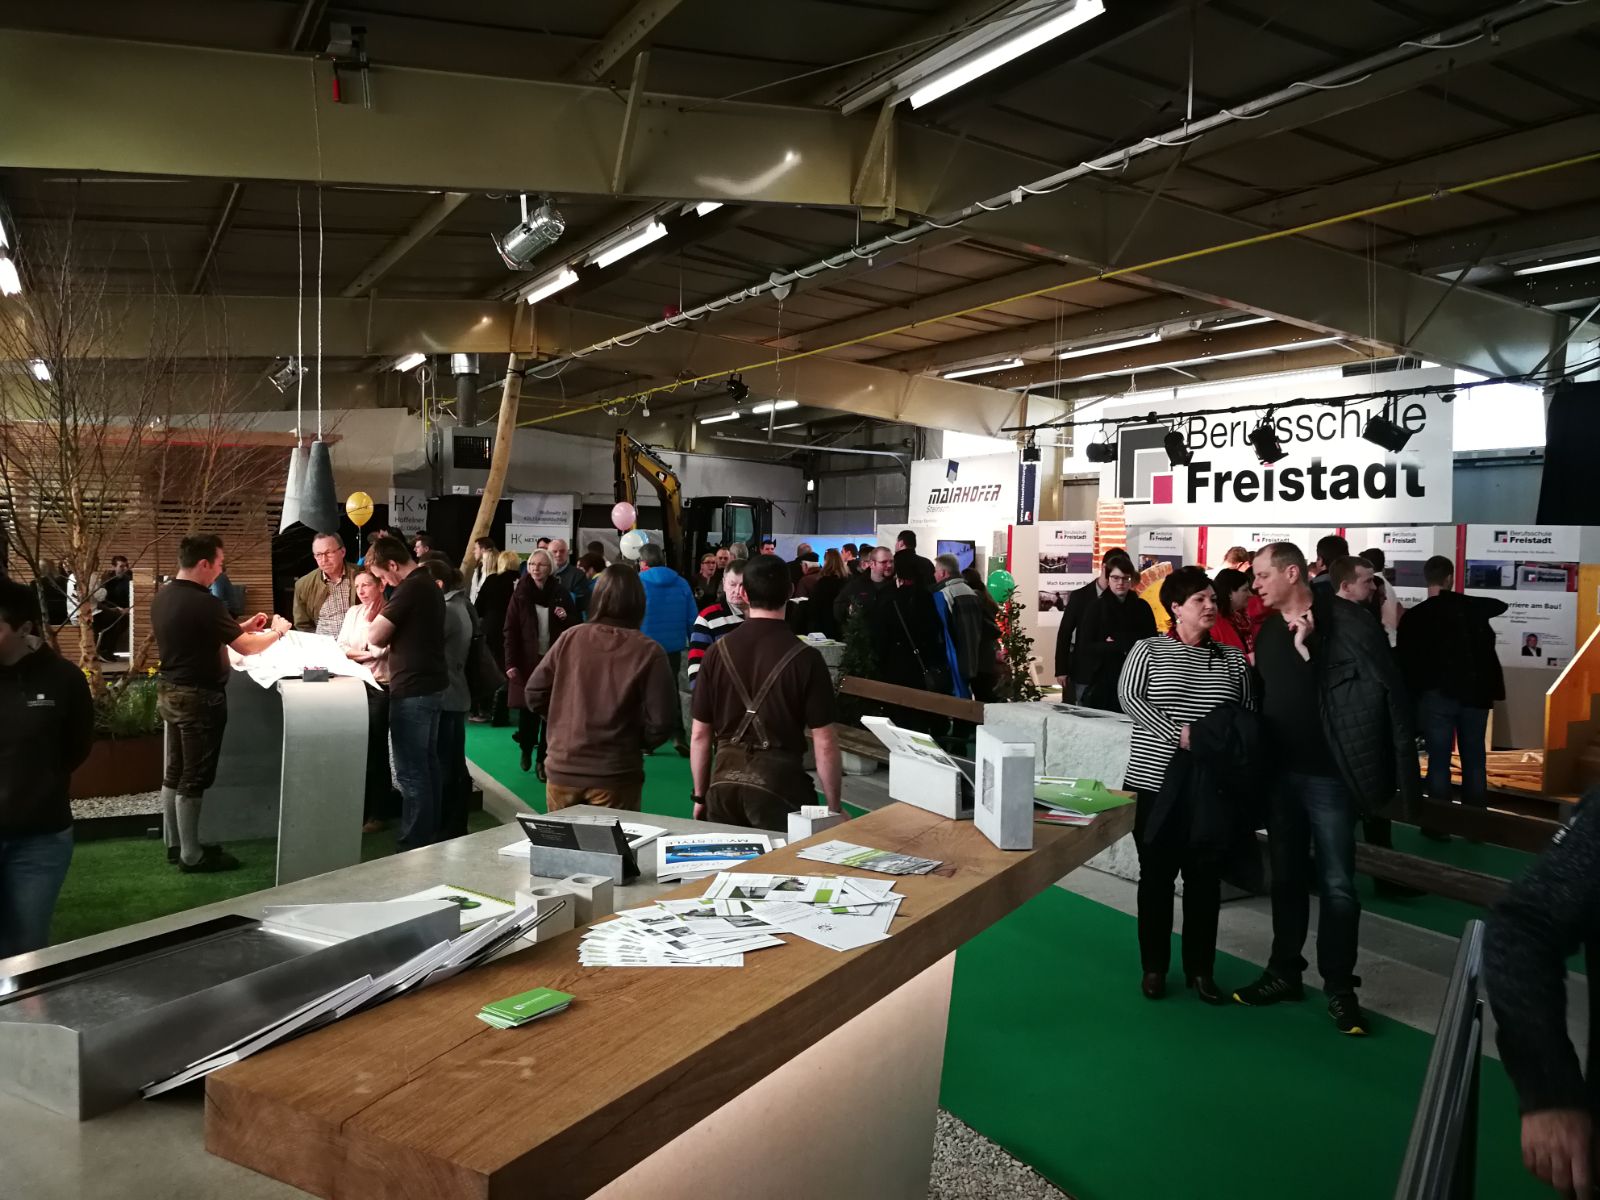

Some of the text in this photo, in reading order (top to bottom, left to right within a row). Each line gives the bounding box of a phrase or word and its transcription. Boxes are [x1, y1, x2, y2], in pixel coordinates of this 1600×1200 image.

[1188, 398, 1426, 450] Berusschle
[927, 484, 1002, 504] MAIRHOFER
[1187, 455, 1425, 503] Freistadt
[1509, 536, 1552, 544] Freistadt
